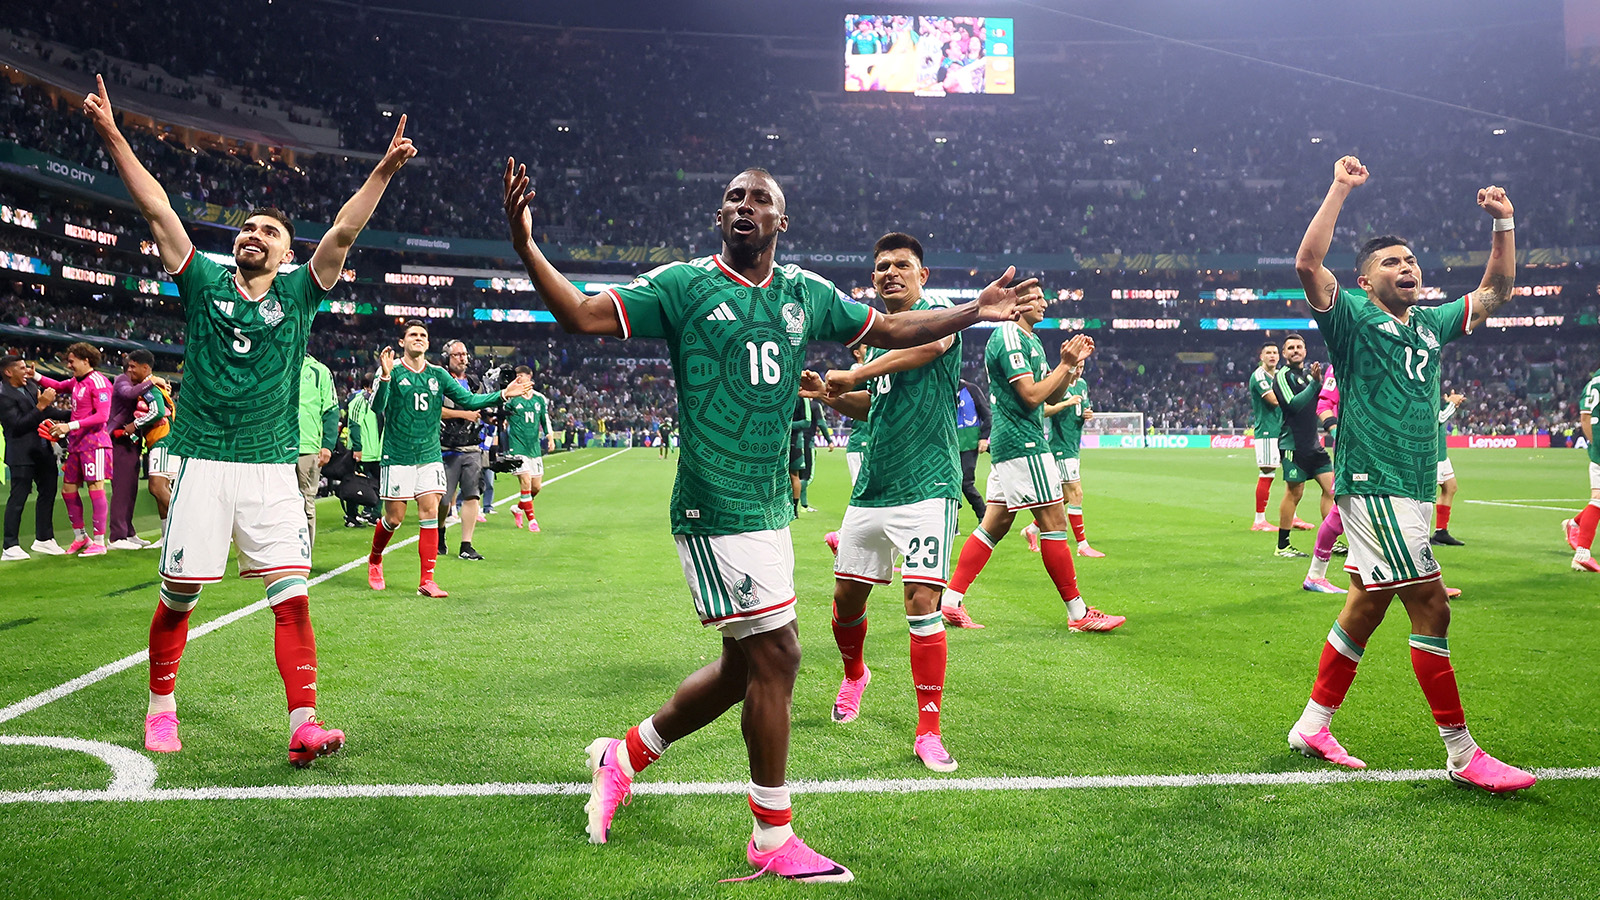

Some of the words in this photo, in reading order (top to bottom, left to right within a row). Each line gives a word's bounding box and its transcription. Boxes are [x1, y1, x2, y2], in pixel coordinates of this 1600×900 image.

[70, 169, 95, 184] CITY
[64, 223, 97, 242] MEXICO
[98, 231, 117, 246] CITY
[781, 254, 833, 262] MEICO
[836, 254, 867, 262] CITY
[62, 265, 96, 283] MEXICO
[96, 272, 116, 287] CITY
[385, 272, 427, 285] MEXICO
[428, 275, 454, 286] CITY
[1154, 289, 1179, 299] CITY
[1533, 286, 1563, 296] CITY
[384, 304, 427, 317] MEXICO
[428, 307, 454, 318] CITY
[1113, 319, 1153, 329] MEXICO
[1154, 319, 1180, 329] CITY
[1486, 316, 1532, 328] MEXICO
[1534, 315, 1564, 327] CITY
[233, 327, 251, 354] 5
[746, 341, 781, 386] 16
[1404, 346, 1429, 382] 17
[413, 392, 429, 411] 15
[524, 411, 535, 423] 14
[1468, 436, 1517, 448] Lenovo
[84, 462, 96, 477] 13
[153, 458, 159, 470] 7
[905, 536, 940, 568] 23
